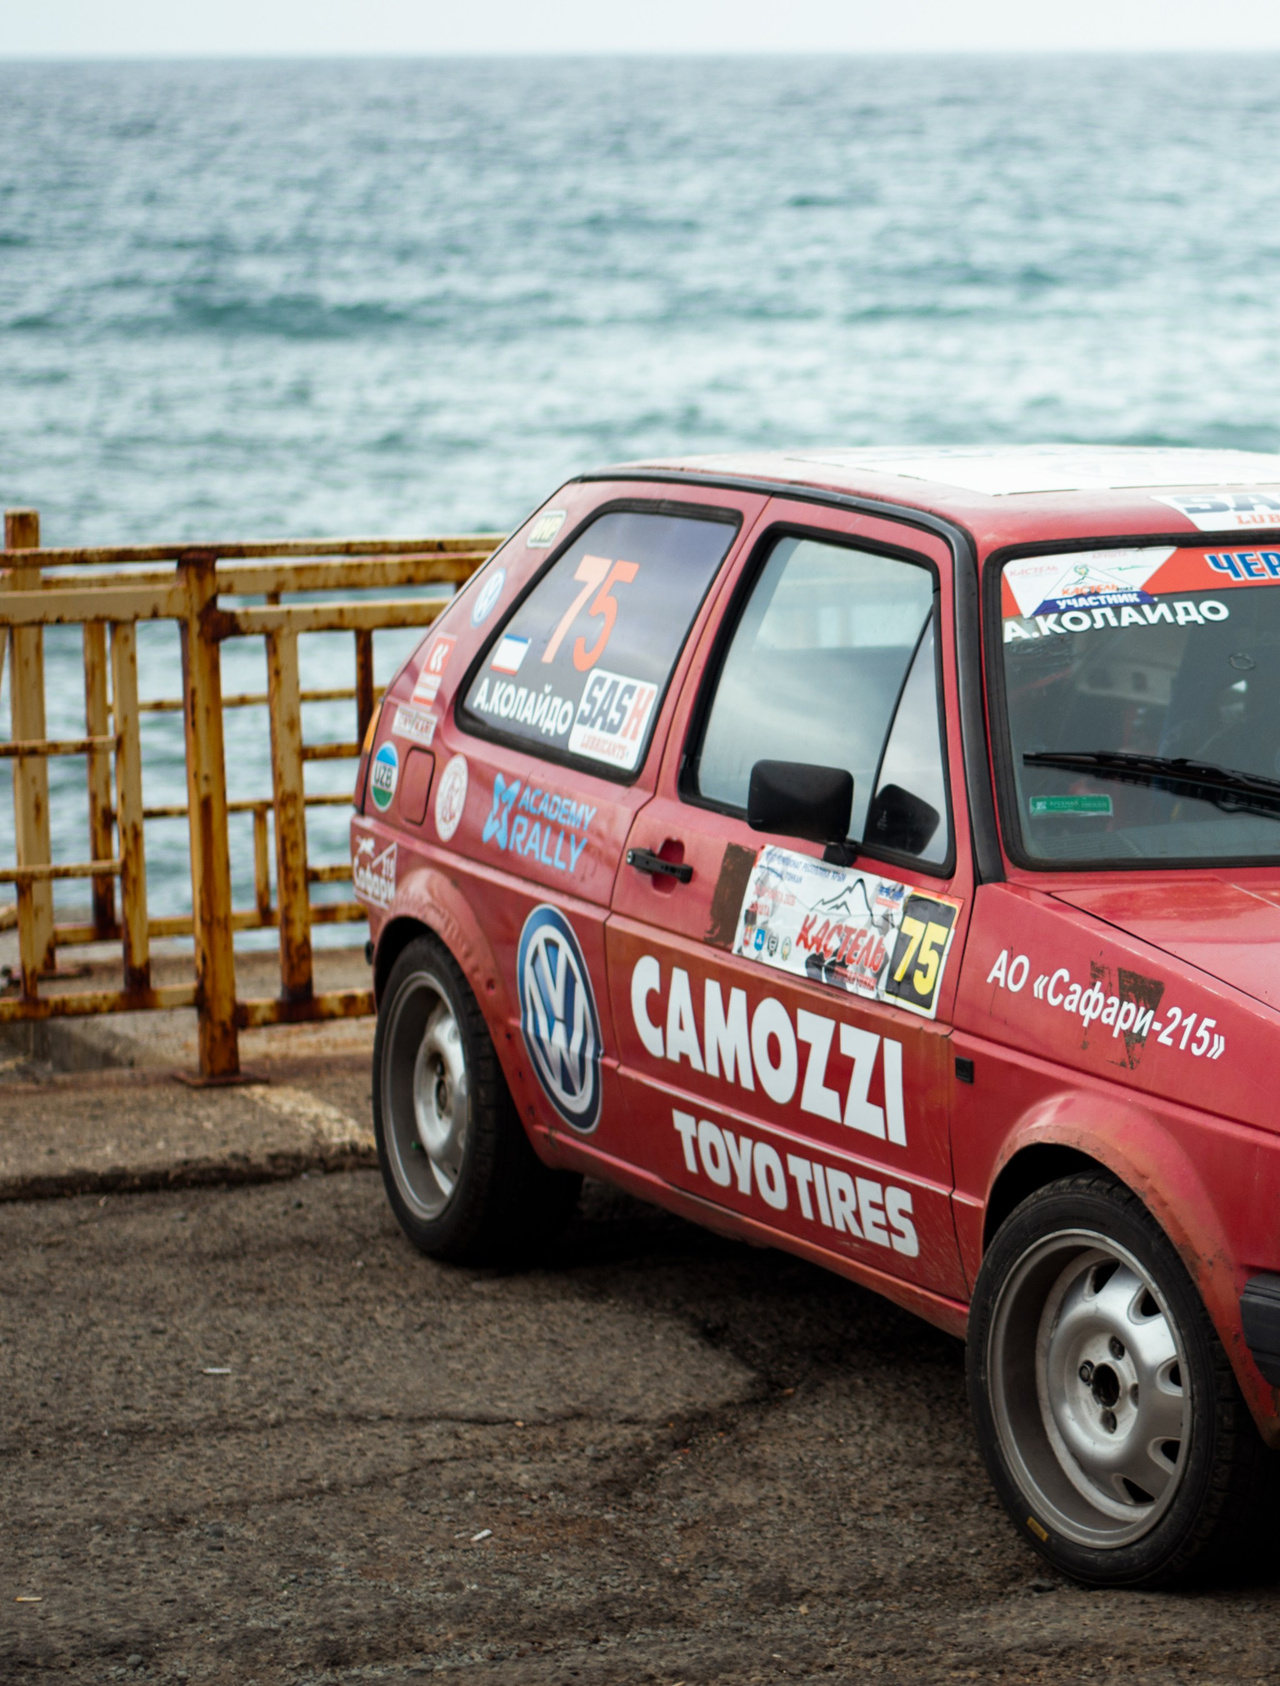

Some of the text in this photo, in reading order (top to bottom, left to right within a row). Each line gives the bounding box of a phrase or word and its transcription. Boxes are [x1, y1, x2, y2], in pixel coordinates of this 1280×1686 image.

[541, 554, 640, 672] 75
[1056, 592, 1141, 609] УЧАСТНИК
[473, 676, 574, 737] А.КОЛАЙДО
[576, 675, 655, 741] SASH
[374, 764, 393, 788] UZB
[580, 733, 629, 760] LUBRICANTS
[518, 785, 597, 831] ACADEMY
[508, 814, 588, 873] RALLY
[796, 913, 888, 973] КАСТЕЛЬ
[893, 915, 949, 996] 75
[986, 948, 1225, 1060] АО «Сафари-215»
[631, 955, 908, 1147] CAMOZZI
[672, 1108, 920, 1258] TOYO TIRES
